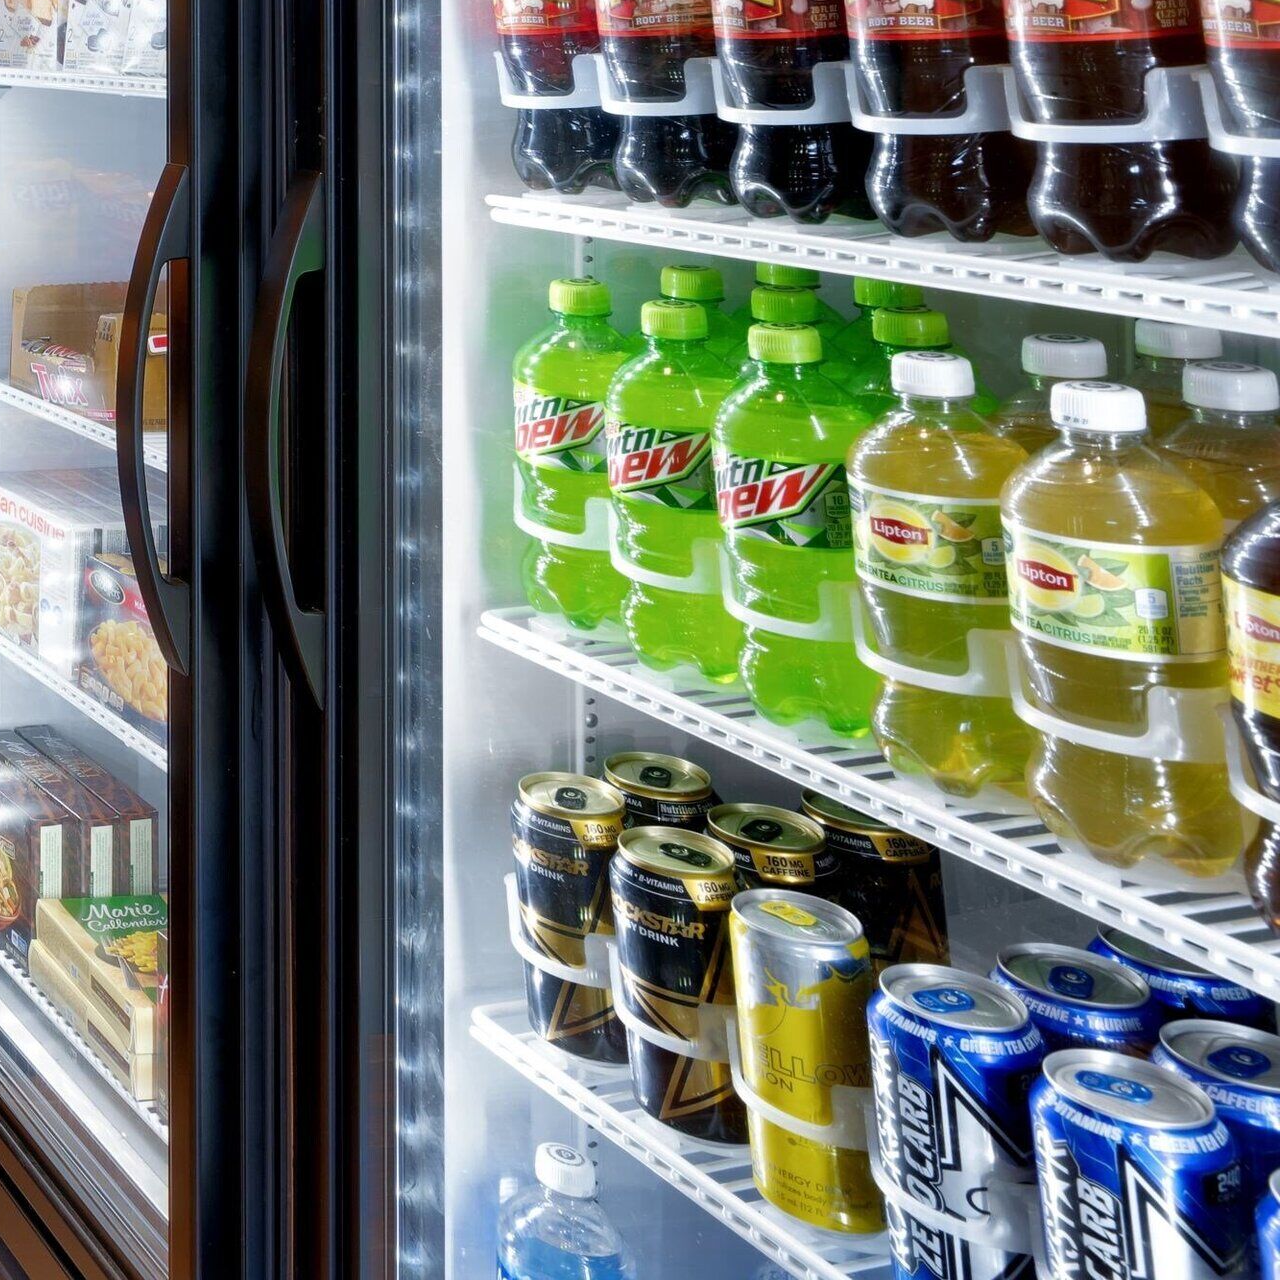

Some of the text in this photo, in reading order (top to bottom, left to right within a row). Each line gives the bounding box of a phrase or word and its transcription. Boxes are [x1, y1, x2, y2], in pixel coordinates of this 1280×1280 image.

[636, 12, 696, 25] ROOT BEER
[868, 16, 935, 27] ROOT BEER
[1032, 16, 1065, 28] BEER
[1221, 20, 1252, 33] BEER
[872, 520, 924, 542] Lipton
[1018, 563, 1069, 586] Lipton
[1175, 564, 1214, 574] Nutrition
[879, 570, 944, 593] TEA CITRUS
[1177, 577, 1203, 585] Facts
[1147, 593, 1156, 604] 5
[1043, 623, 1091, 645] CITRUS
[583, 822, 604, 835] 160
[884, 837, 904, 850] 160
[884, 846, 928, 858] CAFFEINE
[764, 854, 804, 869] 160 MG
[530, 862, 566, 883] DRINK
[761, 864, 811, 879] CAFFEINE
[638, 873, 684, 894] B-VITAMINS
[696, 880, 716, 894] 160
[83, 901, 159, 922] Marie
[639, 927, 680, 948] DRINK
[959, 1038, 1024, 1054] GREEN TEA
